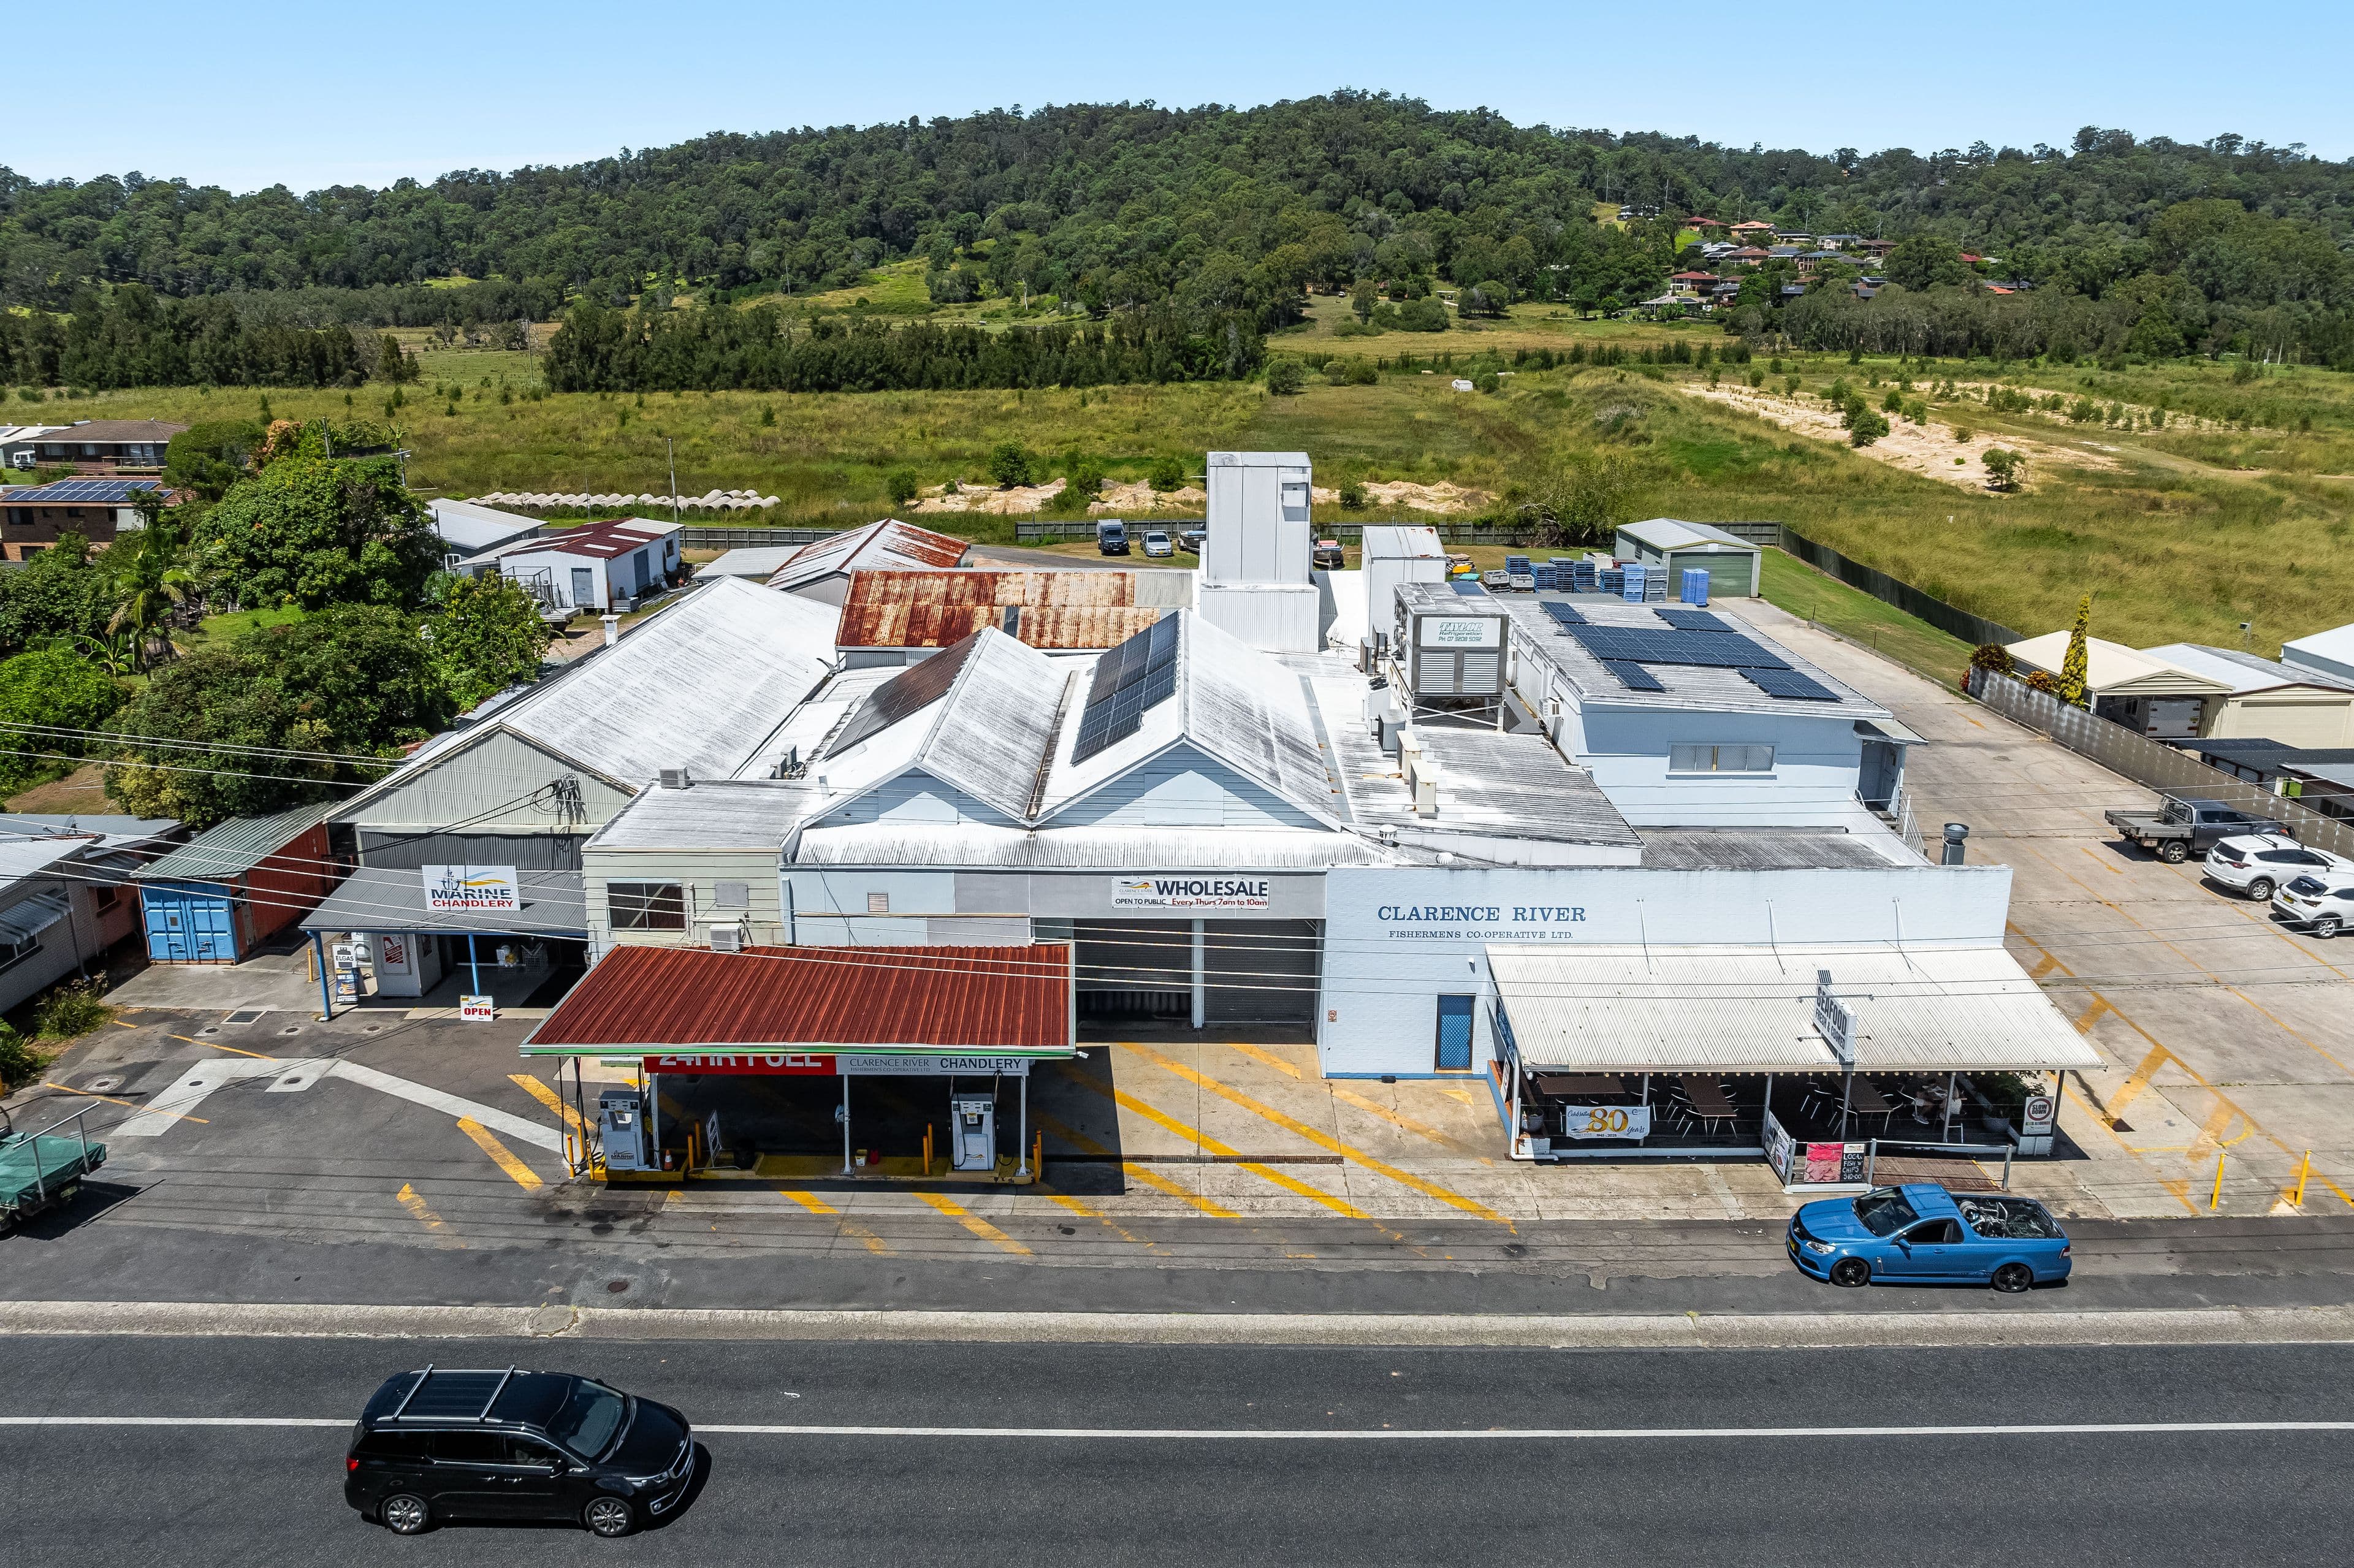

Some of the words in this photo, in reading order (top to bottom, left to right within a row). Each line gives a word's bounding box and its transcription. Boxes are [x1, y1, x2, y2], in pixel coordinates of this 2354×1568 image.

[1439, 622, 1484, 631] TAYLOR
[431, 888, 512, 899] MARINE
[1155, 880, 1268, 896] WHOLESALE
[1172, 898, 1193, 907] Every
[1377, 906, 1499, 921] CLARENCE
[1512, 907, 1586, 922] RIVER
[1816, 986, 1848, 1036] SEAFOOD
[1815, 1008, 1827, 1029] FRESH
[1827, 1021, 1830, 1033] &
[1830, 1026, 1845, 1050] COOKED
[850, 1058, 899, 1067] CLARENCE
[903, 1058, 930, 1067] RIVER
[940, 1058, 1022, 1069] CHANDLERY
[1588, 1108, 1628, 1132] 80
